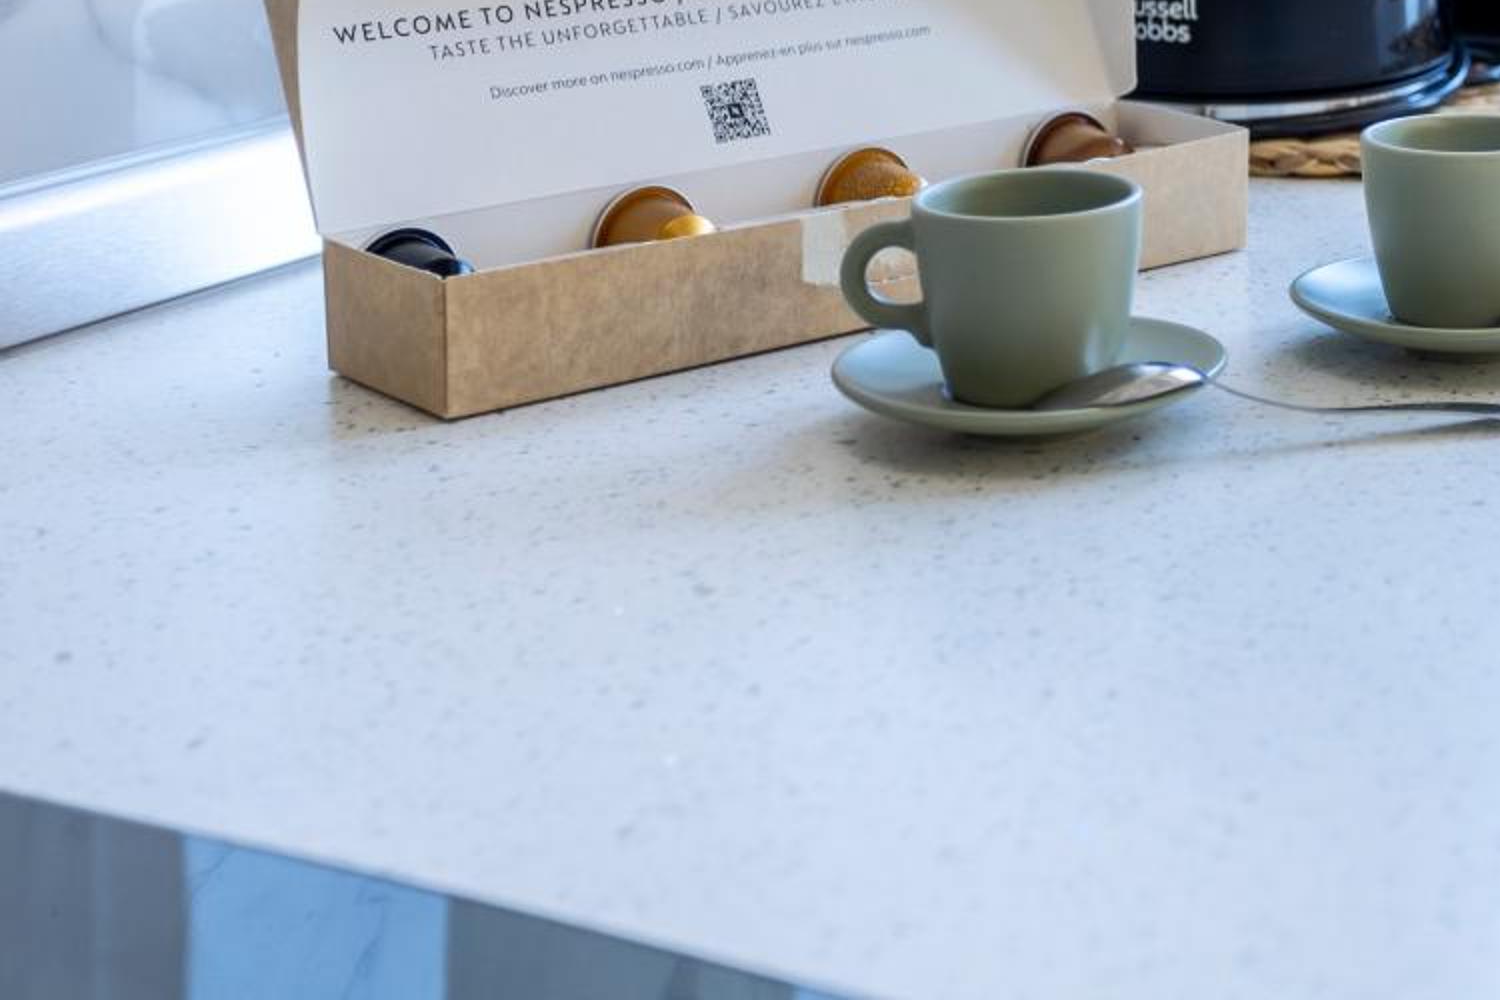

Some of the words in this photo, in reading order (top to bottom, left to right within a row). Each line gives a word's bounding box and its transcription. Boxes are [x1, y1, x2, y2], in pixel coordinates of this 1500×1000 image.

[333, 9, 474, 45] WELCOME
[480, 5, 514, 26] TO
[429, 38, 491, 61] TASTE
[497, 31, 537, 51] THE
[542, 10, 709, 46] UNFORGETTABLE
[715, 6, 722, 24] /
[1135, 18, 1191, 42] obbs
[490, 81, 548, 100] Discover
[552, 76, 587, 90] more
[590, 72, 609, 85] on
[610, 57, 705, 83] nespresso.com
[799, 40, 824, 56] plus
